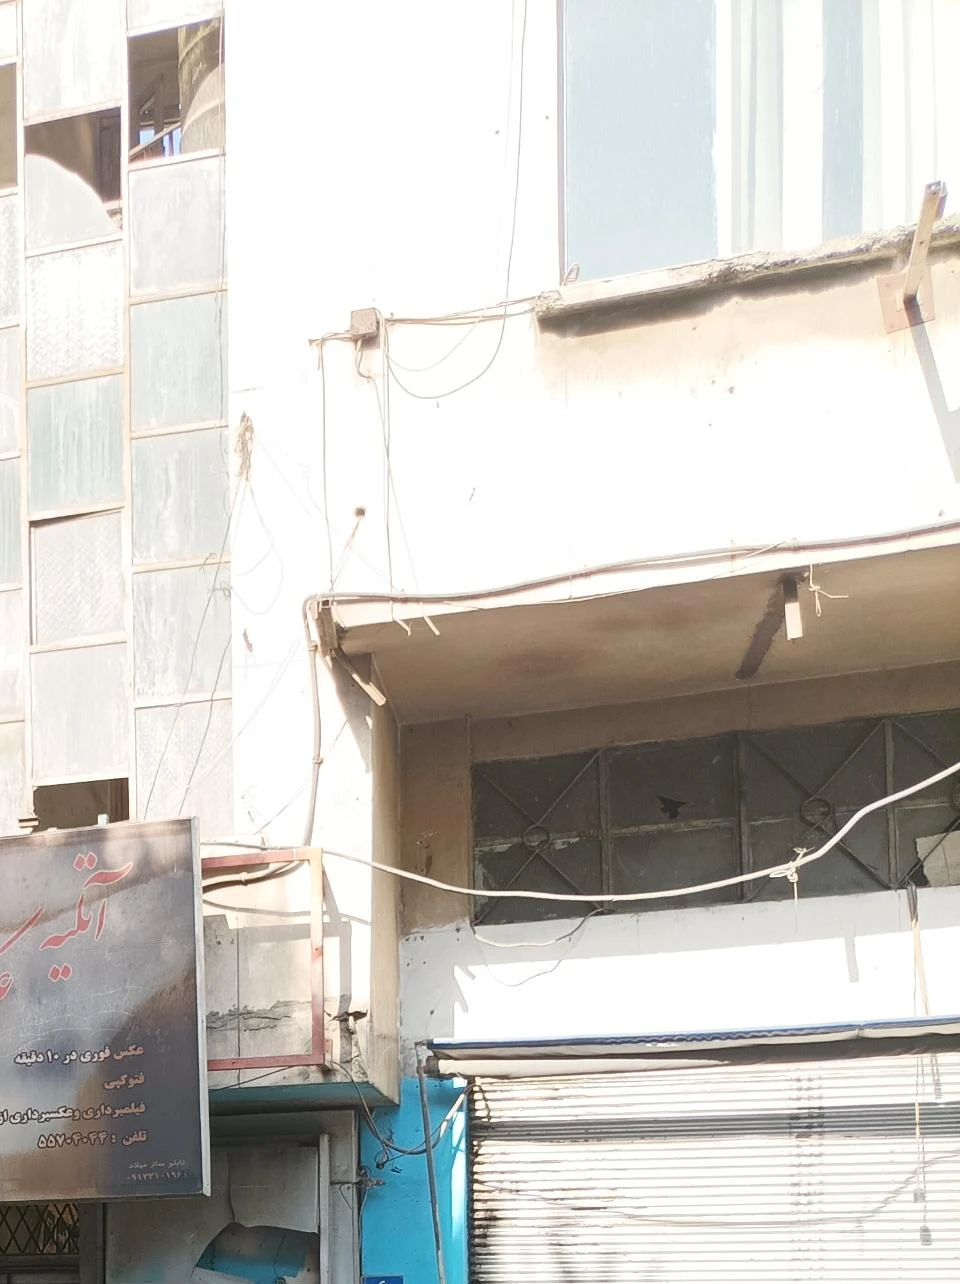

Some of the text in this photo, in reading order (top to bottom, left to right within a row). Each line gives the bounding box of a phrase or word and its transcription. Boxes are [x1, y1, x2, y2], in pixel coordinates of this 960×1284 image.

[14, 1045, 145, 1067] عکس فوری در ۱۰ دقیقه
[103, 1072, 145, 1089] فتوکپی
[82, 1101, 146, 1119] فیلمبرداری
[121, 1130, 147, 1146] تلفن
